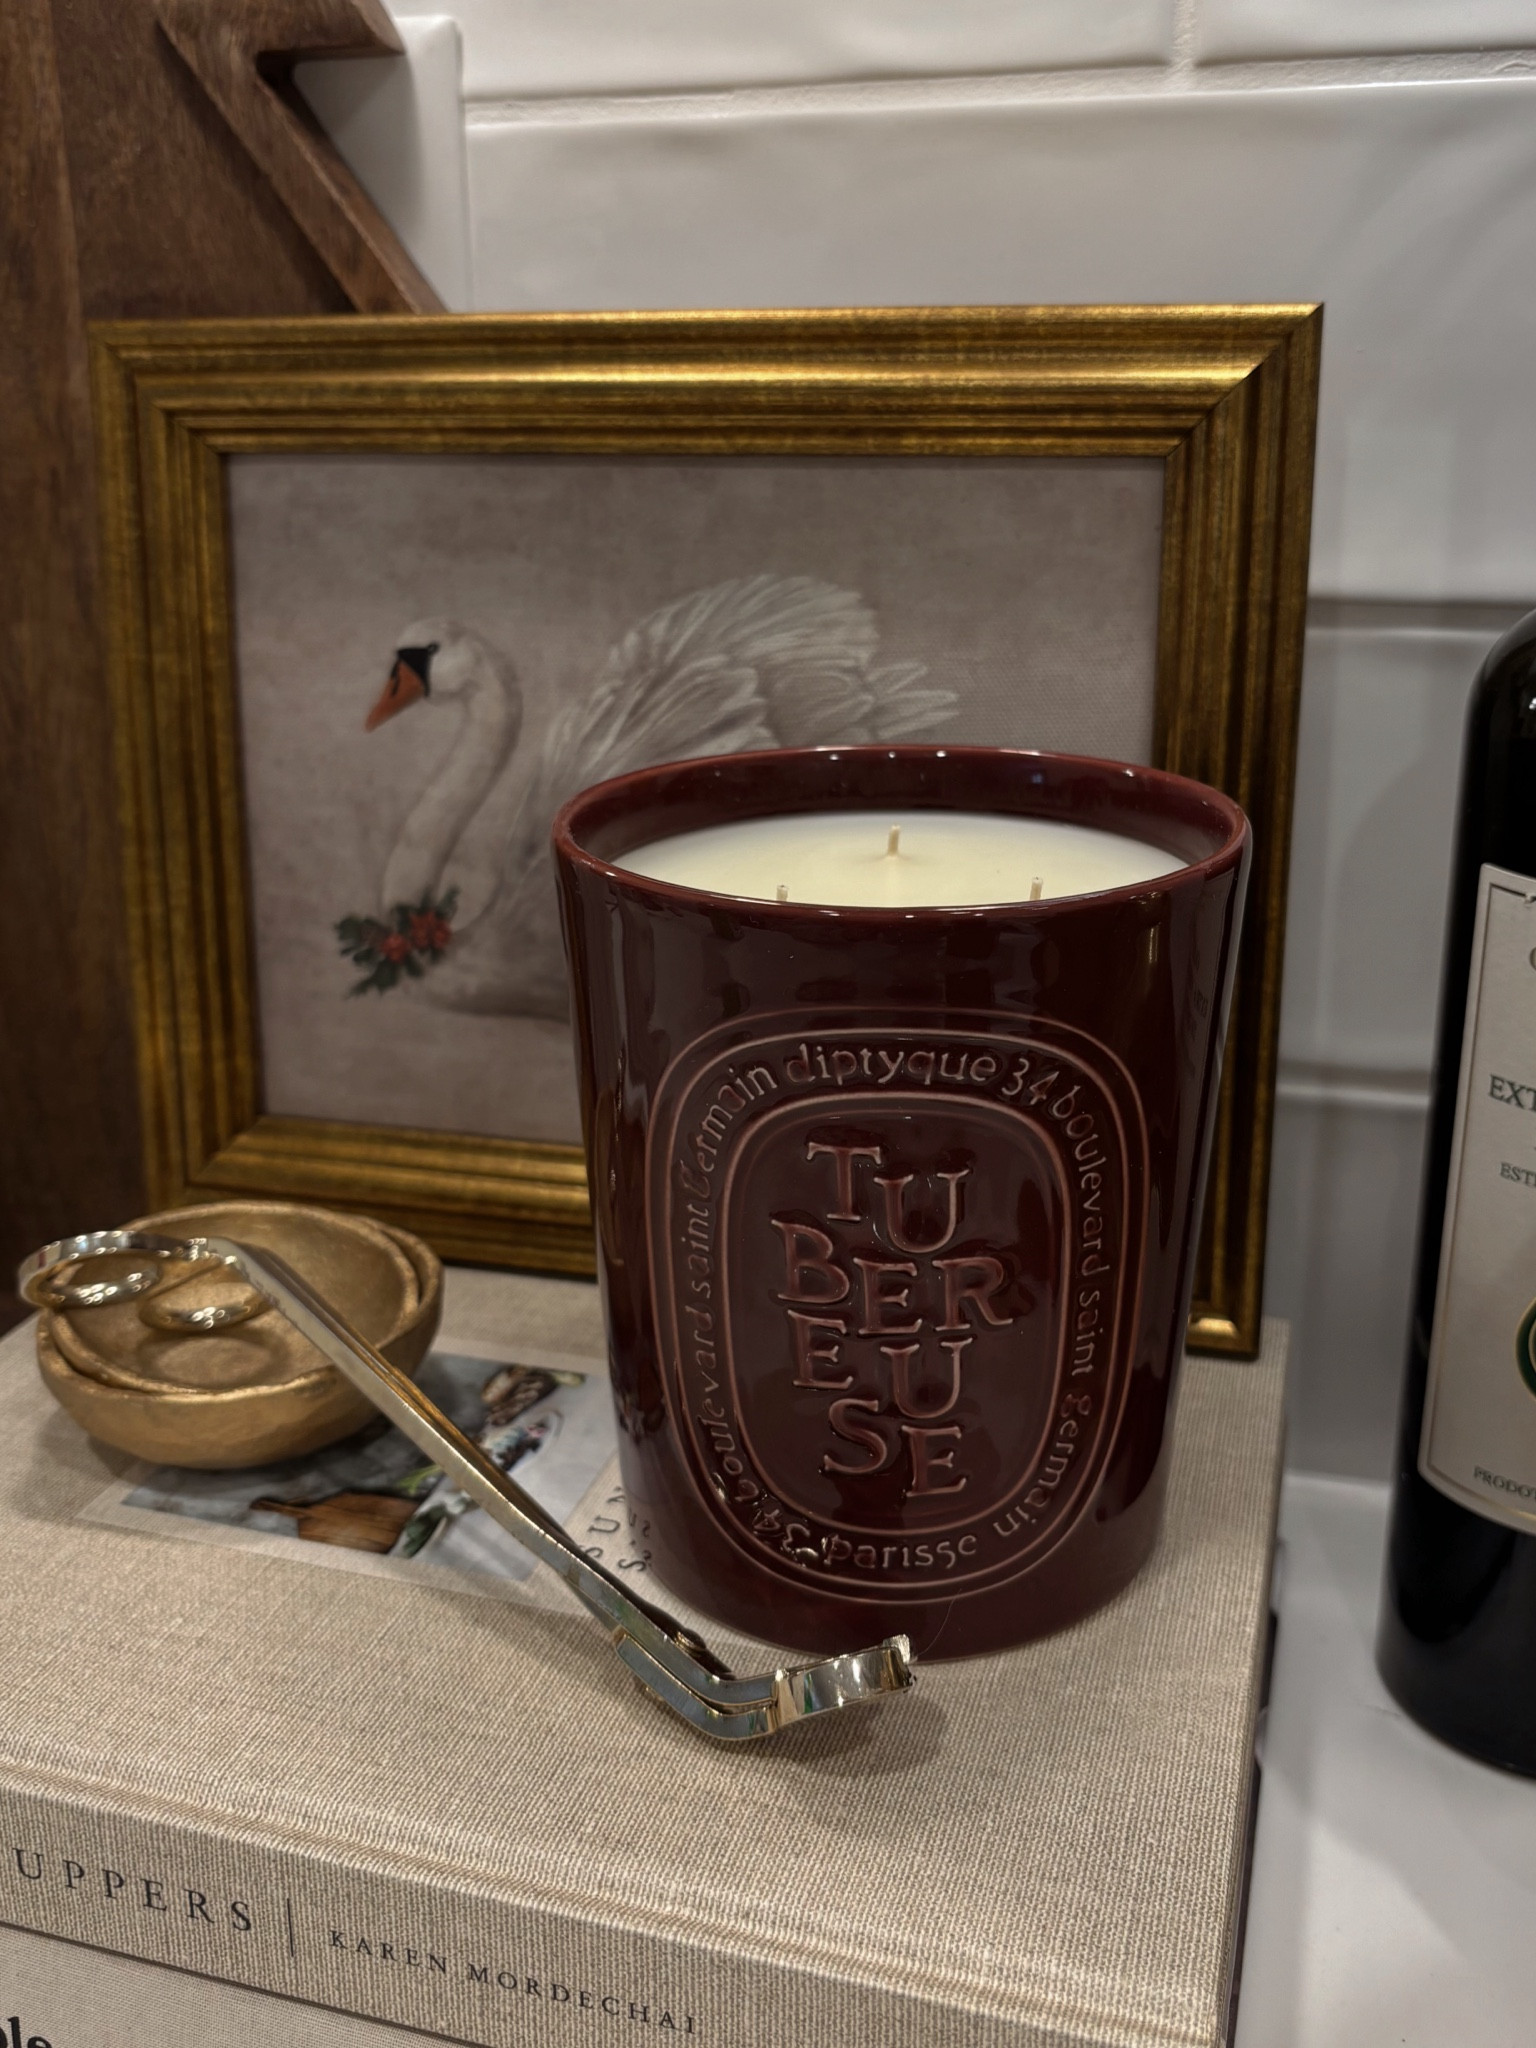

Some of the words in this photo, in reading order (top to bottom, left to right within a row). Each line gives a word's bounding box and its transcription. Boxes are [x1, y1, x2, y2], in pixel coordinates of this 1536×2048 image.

[786, 1042, 998, 1085] diptyque
[1000, 1057, 1060, 1106] 34
[1052, 1085, 1111, 1277] boulevard
[681, 1203, 713, 1299] saint
[1071, 1289, 1105, 1377] saint
[684, 1304, 760, 1501] boulevard
[11, 1846, 252, 1932] UPPERS
[329, 1929, 448, 1974] KAREN
[468, 1963, 697, 2035] MORDECHAI
